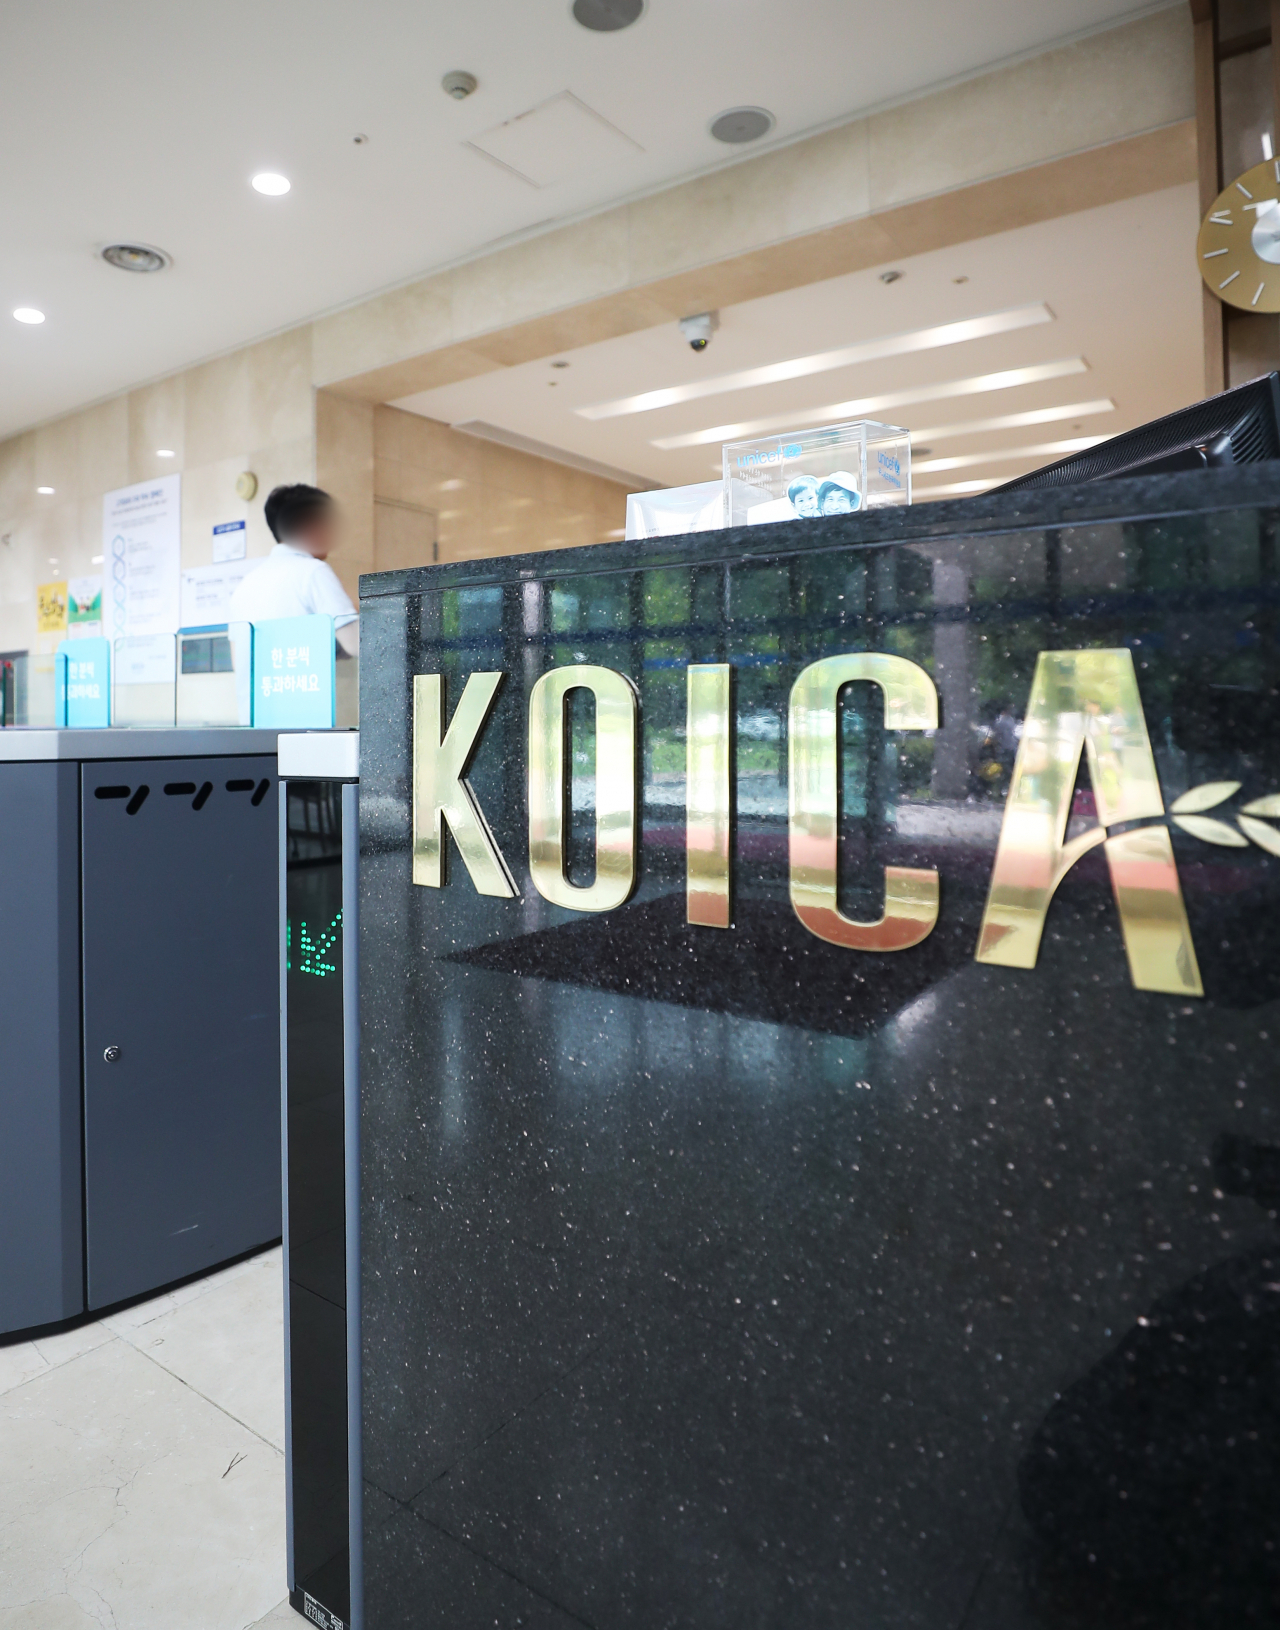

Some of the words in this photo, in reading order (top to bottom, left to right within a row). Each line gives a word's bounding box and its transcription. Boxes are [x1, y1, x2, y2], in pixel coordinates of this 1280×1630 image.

[736, 445, 783, 468] unicef
[270, 647, 284, 669] 한
[286, 646, 311, 668] 분씩
[260, 673, 321, 698] 통과하세요
[413, 648, 1204, 997] KOICA
